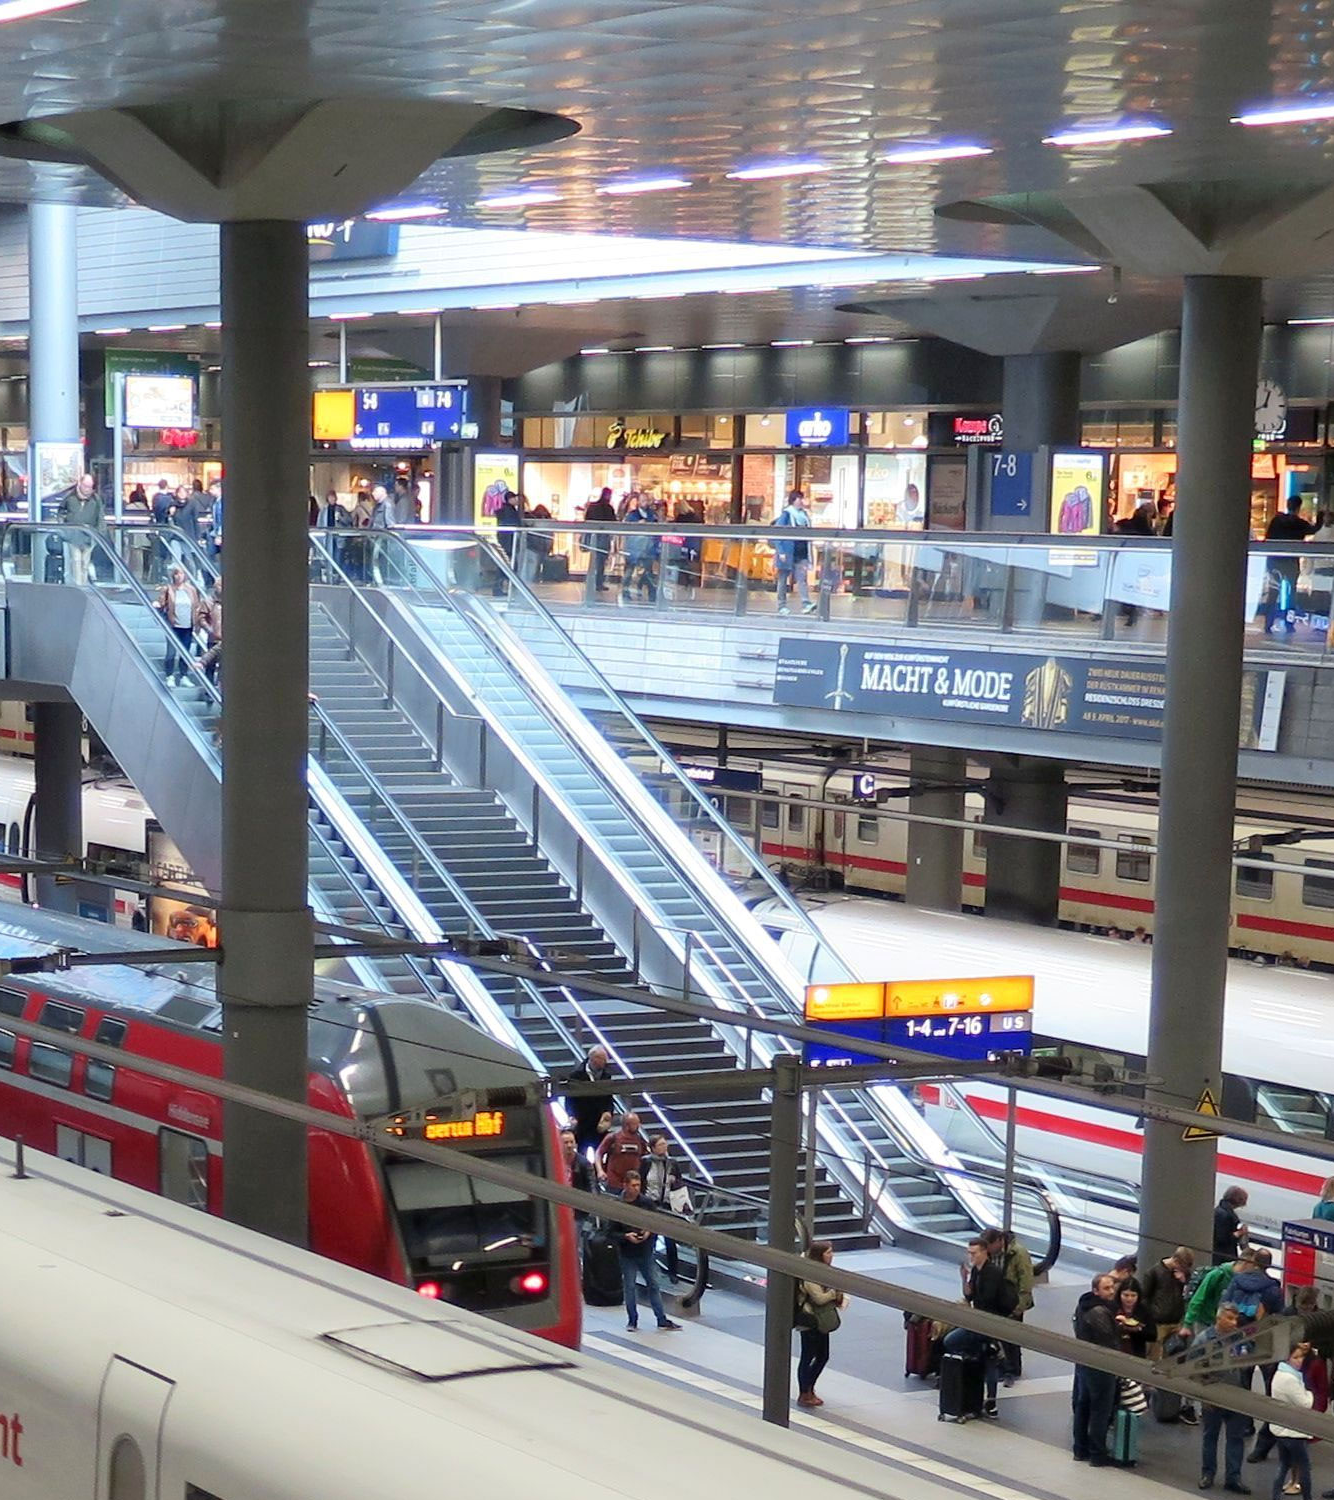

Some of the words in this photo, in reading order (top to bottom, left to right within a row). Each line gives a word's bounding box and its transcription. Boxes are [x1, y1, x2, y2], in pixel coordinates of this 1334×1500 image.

[623, 427, 665, 449] Tchibo
[993, 454, 1018, 477] 7-8
[860, 663, 933, 693] MACHT
[934, 667, 950, 695] &
[952, 669, 1014, 700] MODE
[860, 775, 874, 794] C
[906, 1018, 932, 1038] 1-4
[948, 1016, 982, 1036] 7-16
[1003, 1017, 1013, 1029] U
[1014, 1016, 1025, 1029] S
